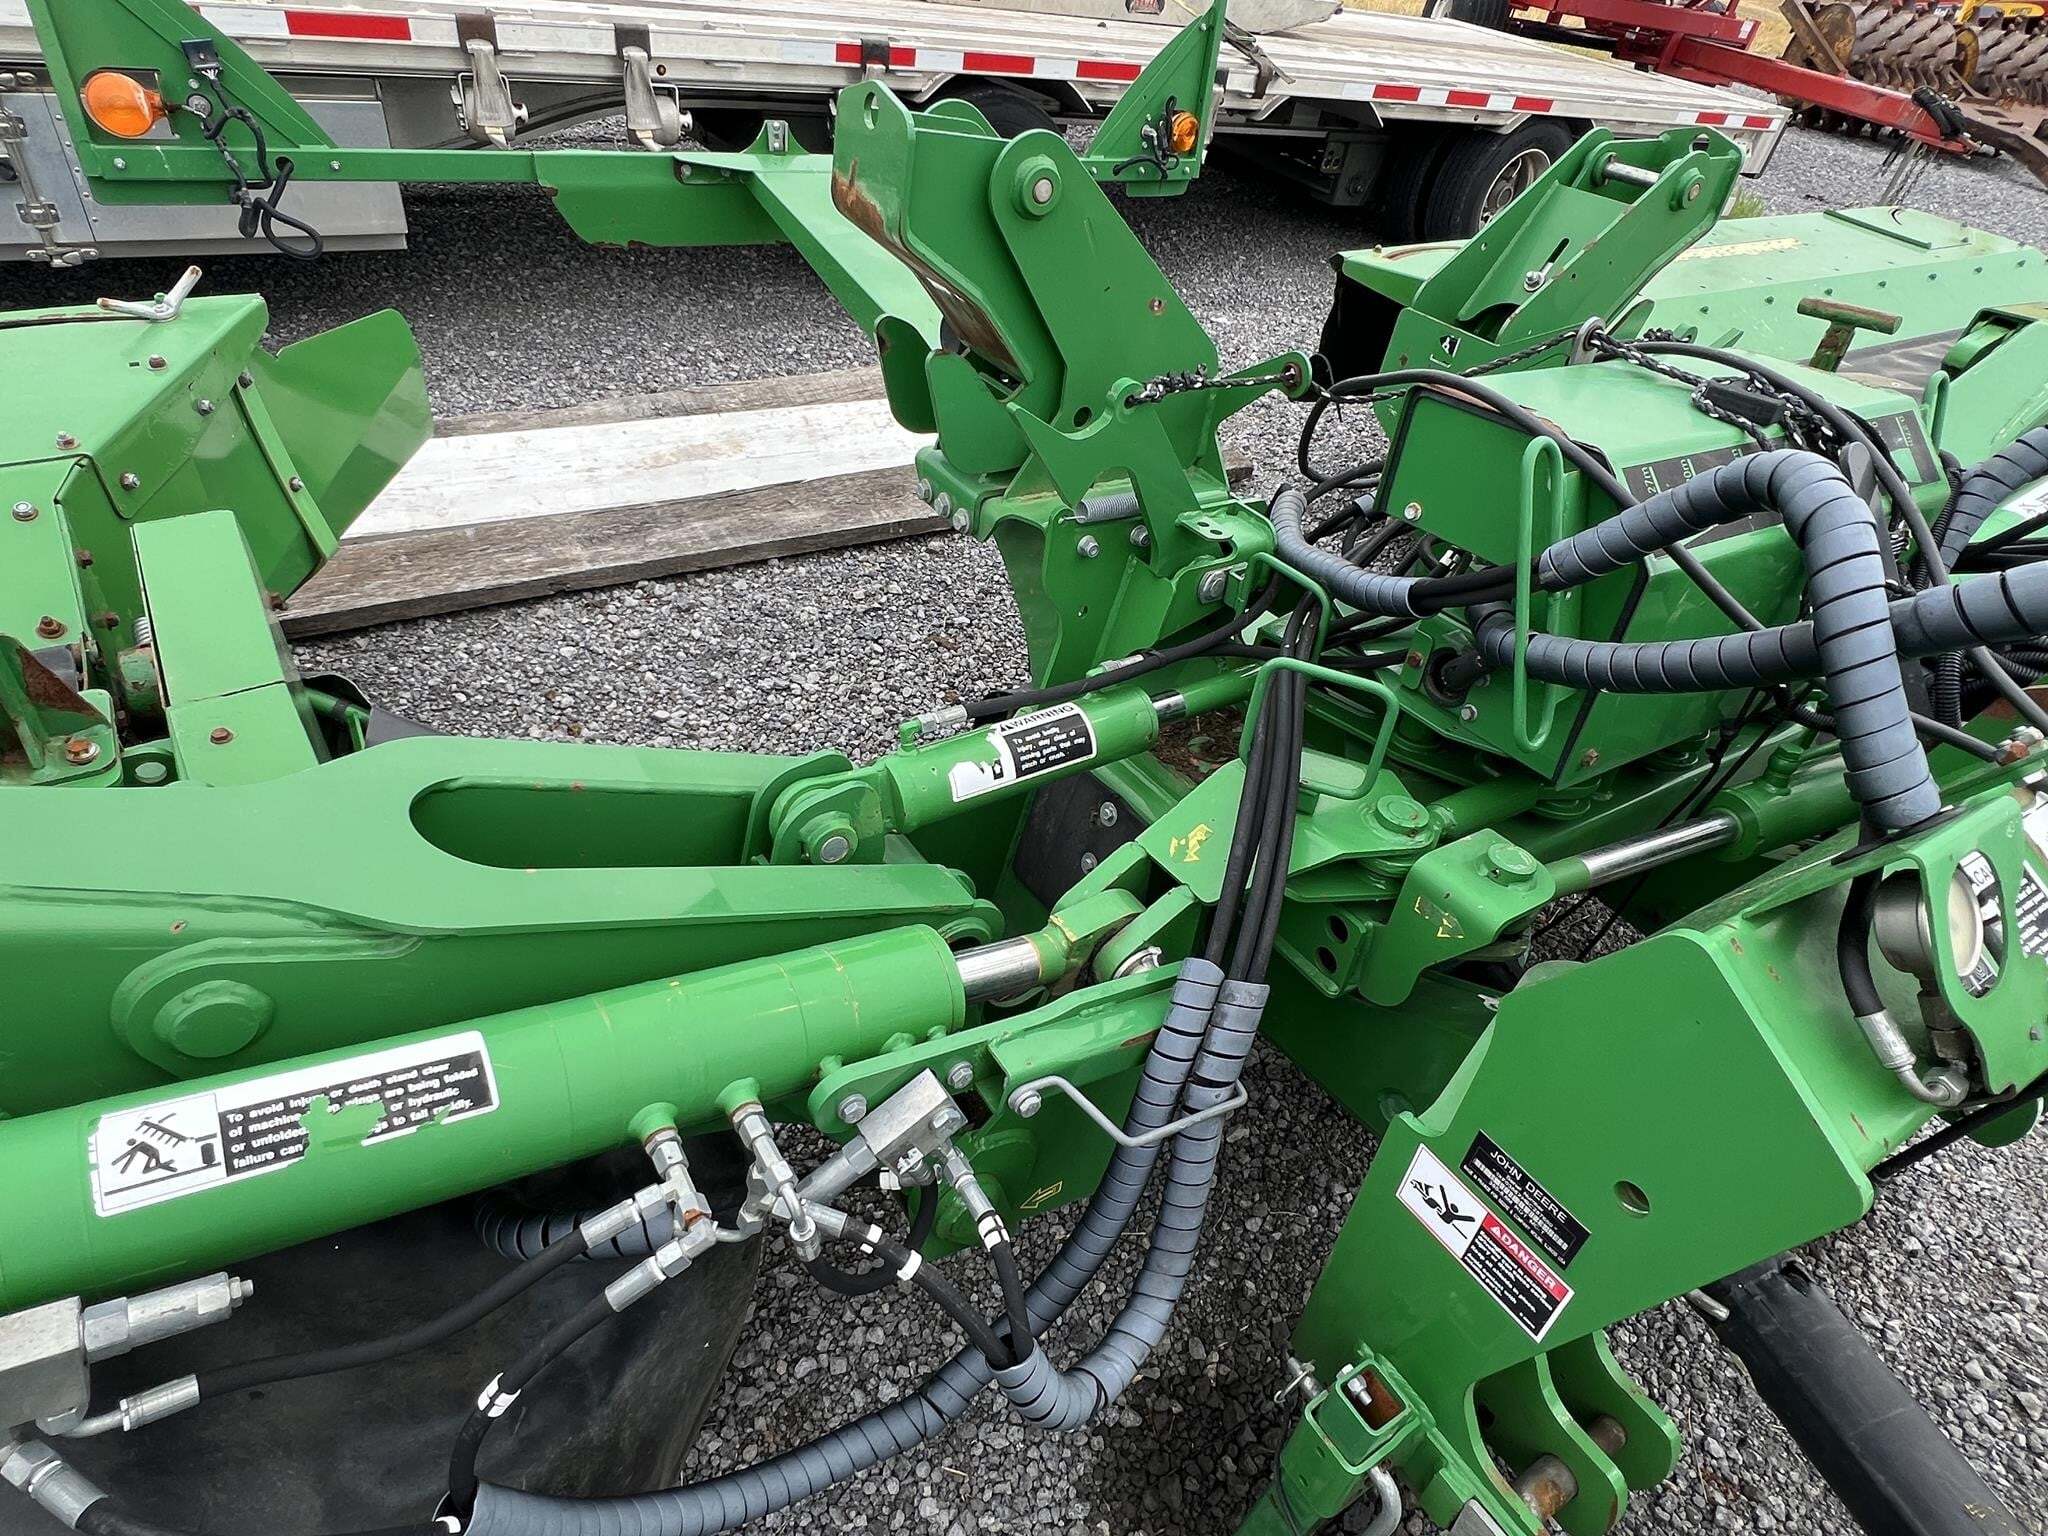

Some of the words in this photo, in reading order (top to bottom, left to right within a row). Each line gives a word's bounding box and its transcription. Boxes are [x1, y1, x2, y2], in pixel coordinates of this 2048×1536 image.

[1013, 704, 1074, 727] WARNING
[226, 1113, 244, 1124] To
[249, 1101, 285, 1119] avoid
[329, 1088, 344, 1099] or
[348, 1079, 382, 1094] death
[385, 1069, 419, 1085] stand
[421, 1062, 451, 1076] clear
[384, 1087, 405, 1099] are
[407, 1078, 441, 1093] being
[443, 1067, 479, 1084] folded
[390, 1101, 404, 1112] or
[407, 1086, 461, 1107] hydraulic
[228, 1125, 243, 1138] of
[248, 1112, 302, 1133] machine
[392, 1115, 406, 1126] to
[409, 1108, 430, 1121] fall
[230, 1142, 247, 1154] or
[233, 1150, 275, 1169] failure
[280, 1142, 303, 1157] can
[1490, 1150, 1522, 1181] JOHN
[1525, 1181, 1568, 1224] DEERE
[1500, 1232, 1557, 1290] DANGER
